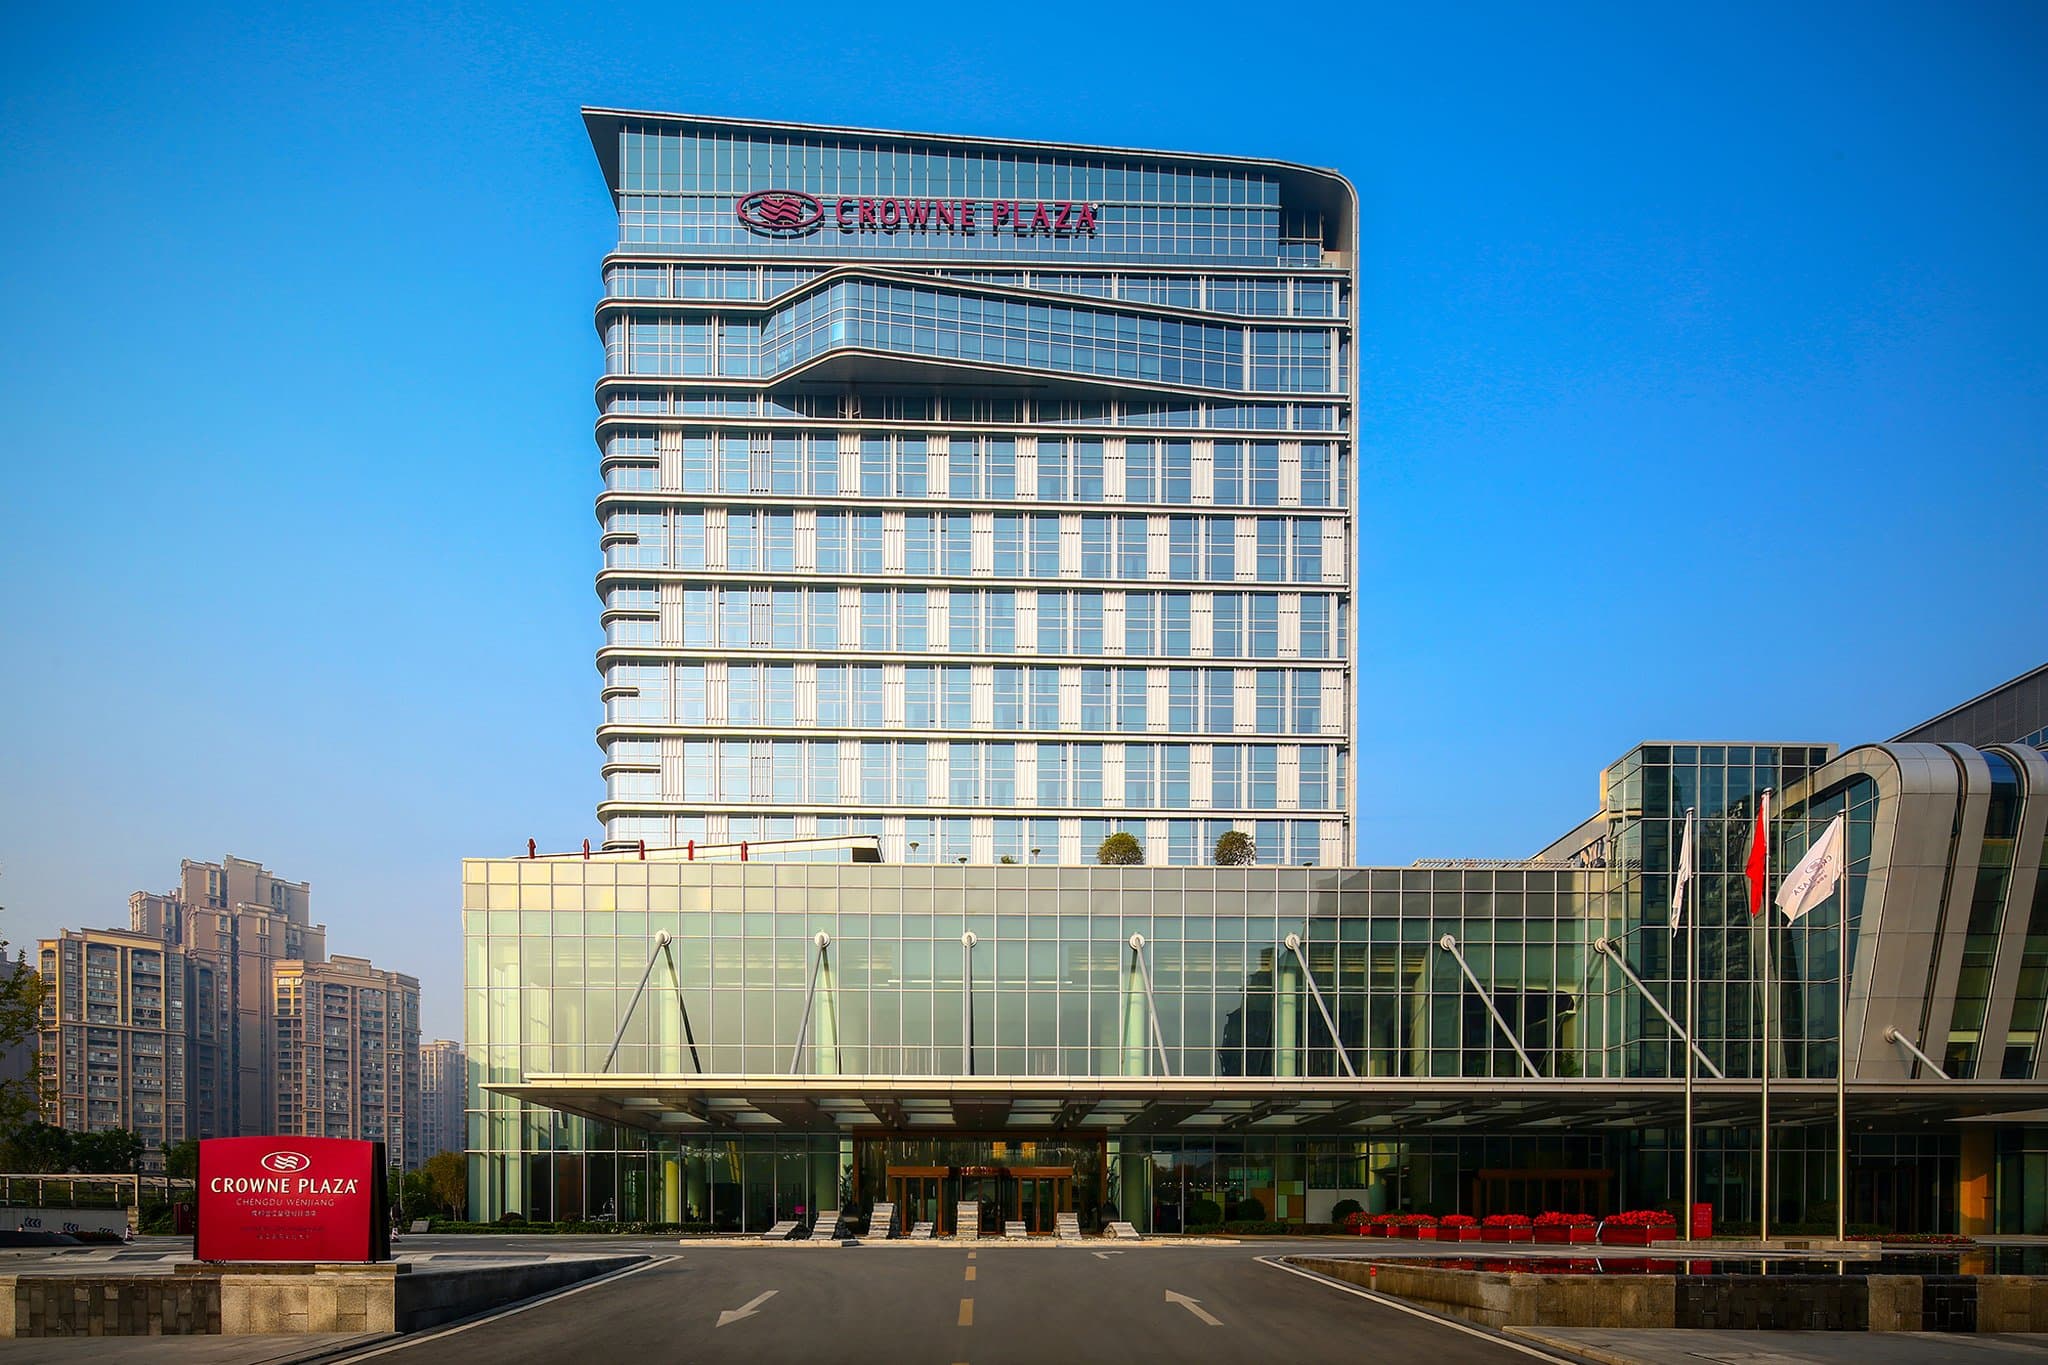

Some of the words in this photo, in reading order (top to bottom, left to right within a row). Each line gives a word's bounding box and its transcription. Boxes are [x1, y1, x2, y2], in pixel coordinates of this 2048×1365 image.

[836, 197, 975, 228] CROWNE
[992, 201, 1096, 231] PLAZA
[210, 1177, 290, 1194] CROWNE
[298, 1178, 357, 1194] PLAZA
[236, 1197, 283, 1206] CHENGDU
[286, 1198, 335, 1207] WENJIANG
